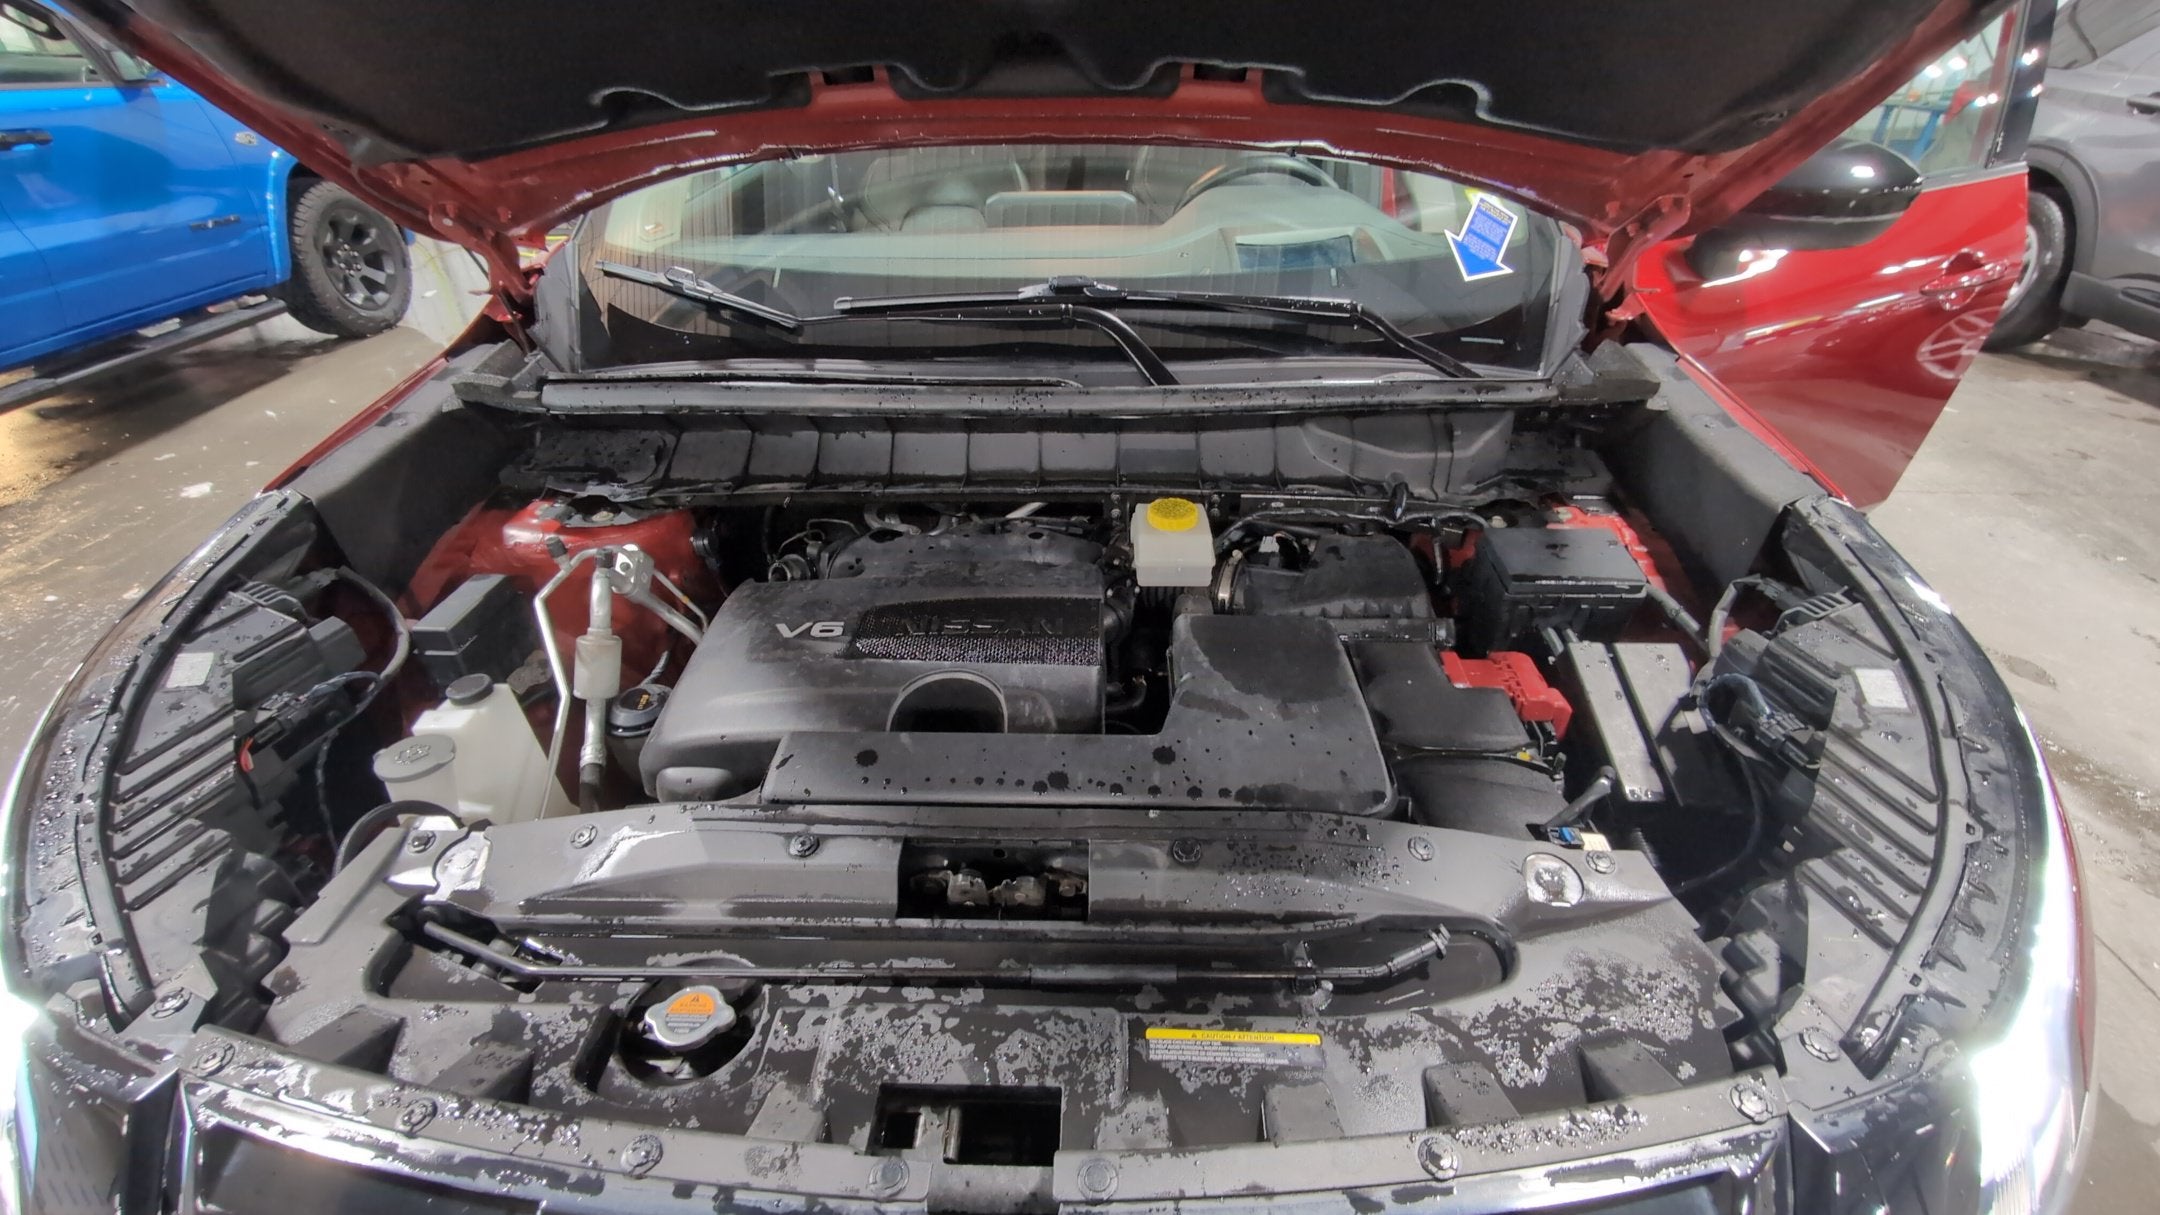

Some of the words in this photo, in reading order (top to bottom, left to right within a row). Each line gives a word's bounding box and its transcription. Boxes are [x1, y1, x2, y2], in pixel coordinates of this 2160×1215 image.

[775, 621, 845, 638] V6
[896, 614, 1063, 635] NISSAN
[1237, 1033, 1275, 1041] ATTENTION
